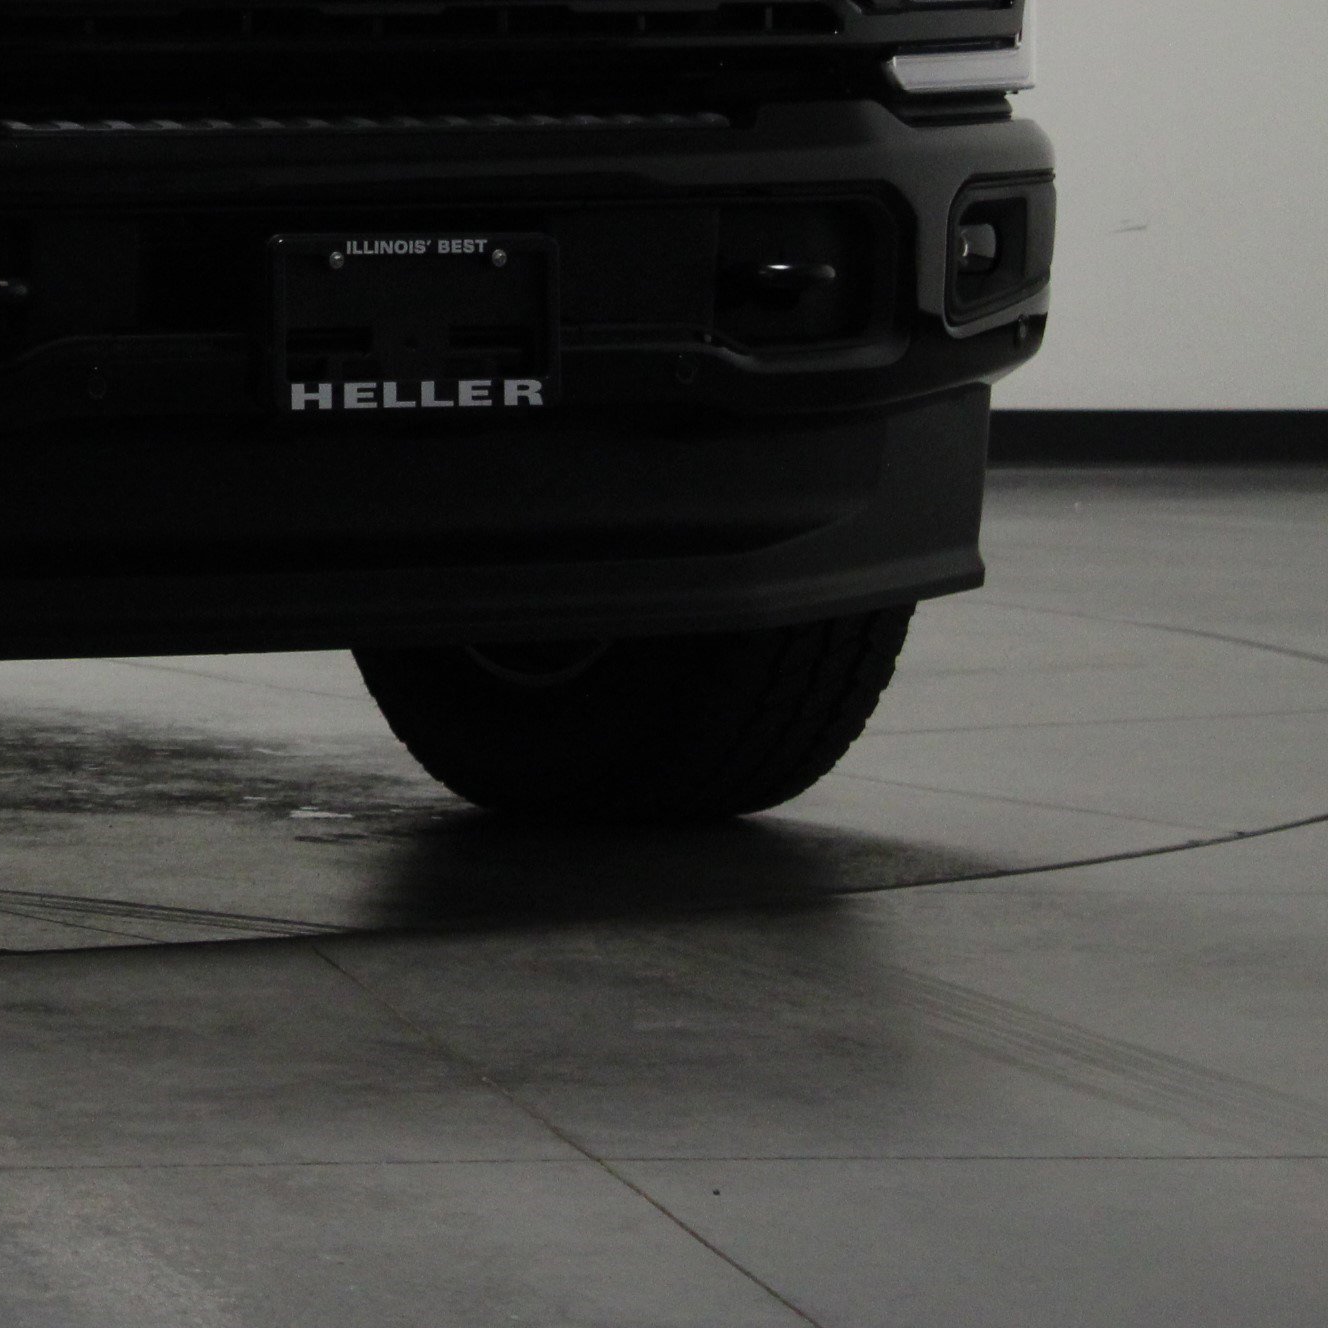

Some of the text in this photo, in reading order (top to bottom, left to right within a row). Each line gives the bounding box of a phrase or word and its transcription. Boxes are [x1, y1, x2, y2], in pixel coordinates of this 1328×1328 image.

[346, 238, 488, 256] ILLINOIS' BEST
[290, 378, 545, 412] HELLER
